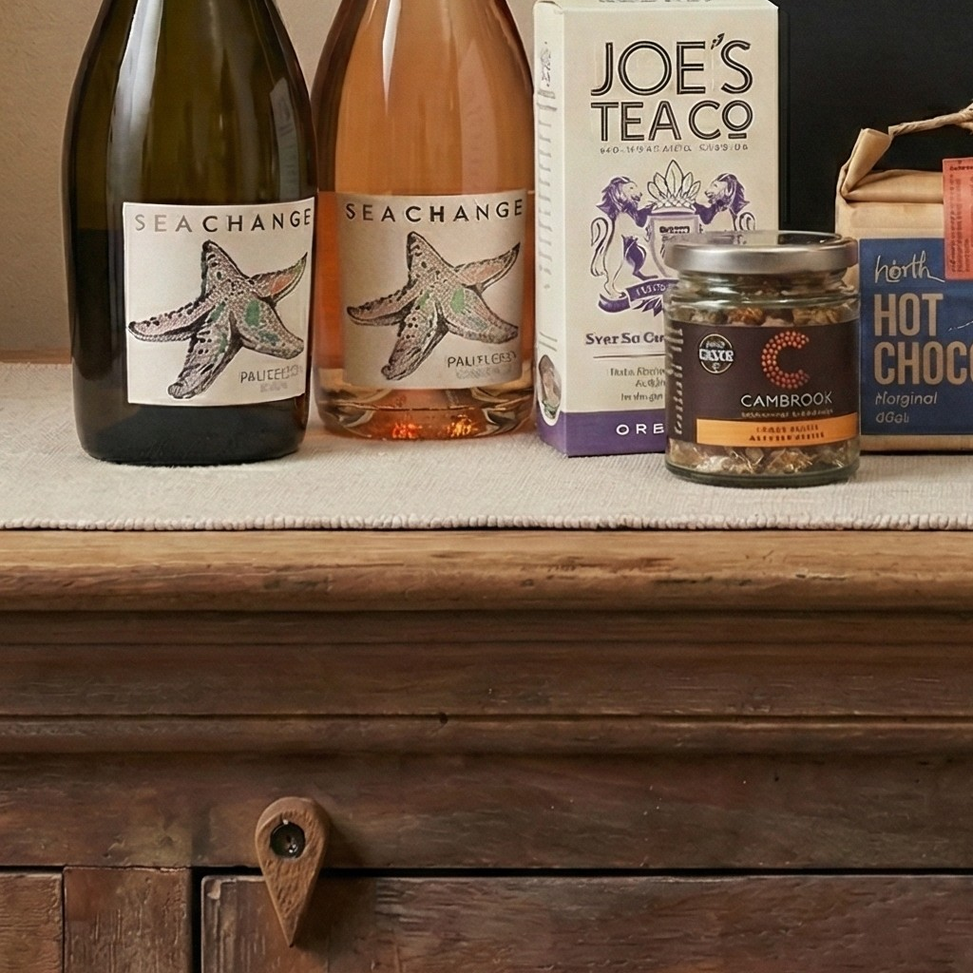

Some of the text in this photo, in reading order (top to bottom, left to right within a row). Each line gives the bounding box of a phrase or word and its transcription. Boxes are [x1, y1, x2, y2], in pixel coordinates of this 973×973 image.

[590, 33, 753, 96] JOE'S
[134, 206, 312, 234] SEACHANGE
[346, 197, 523, 224] SEACHANGE
[873, 292, 944, 337] HOT
[740, 390, 833, 408] CAMBROOK
